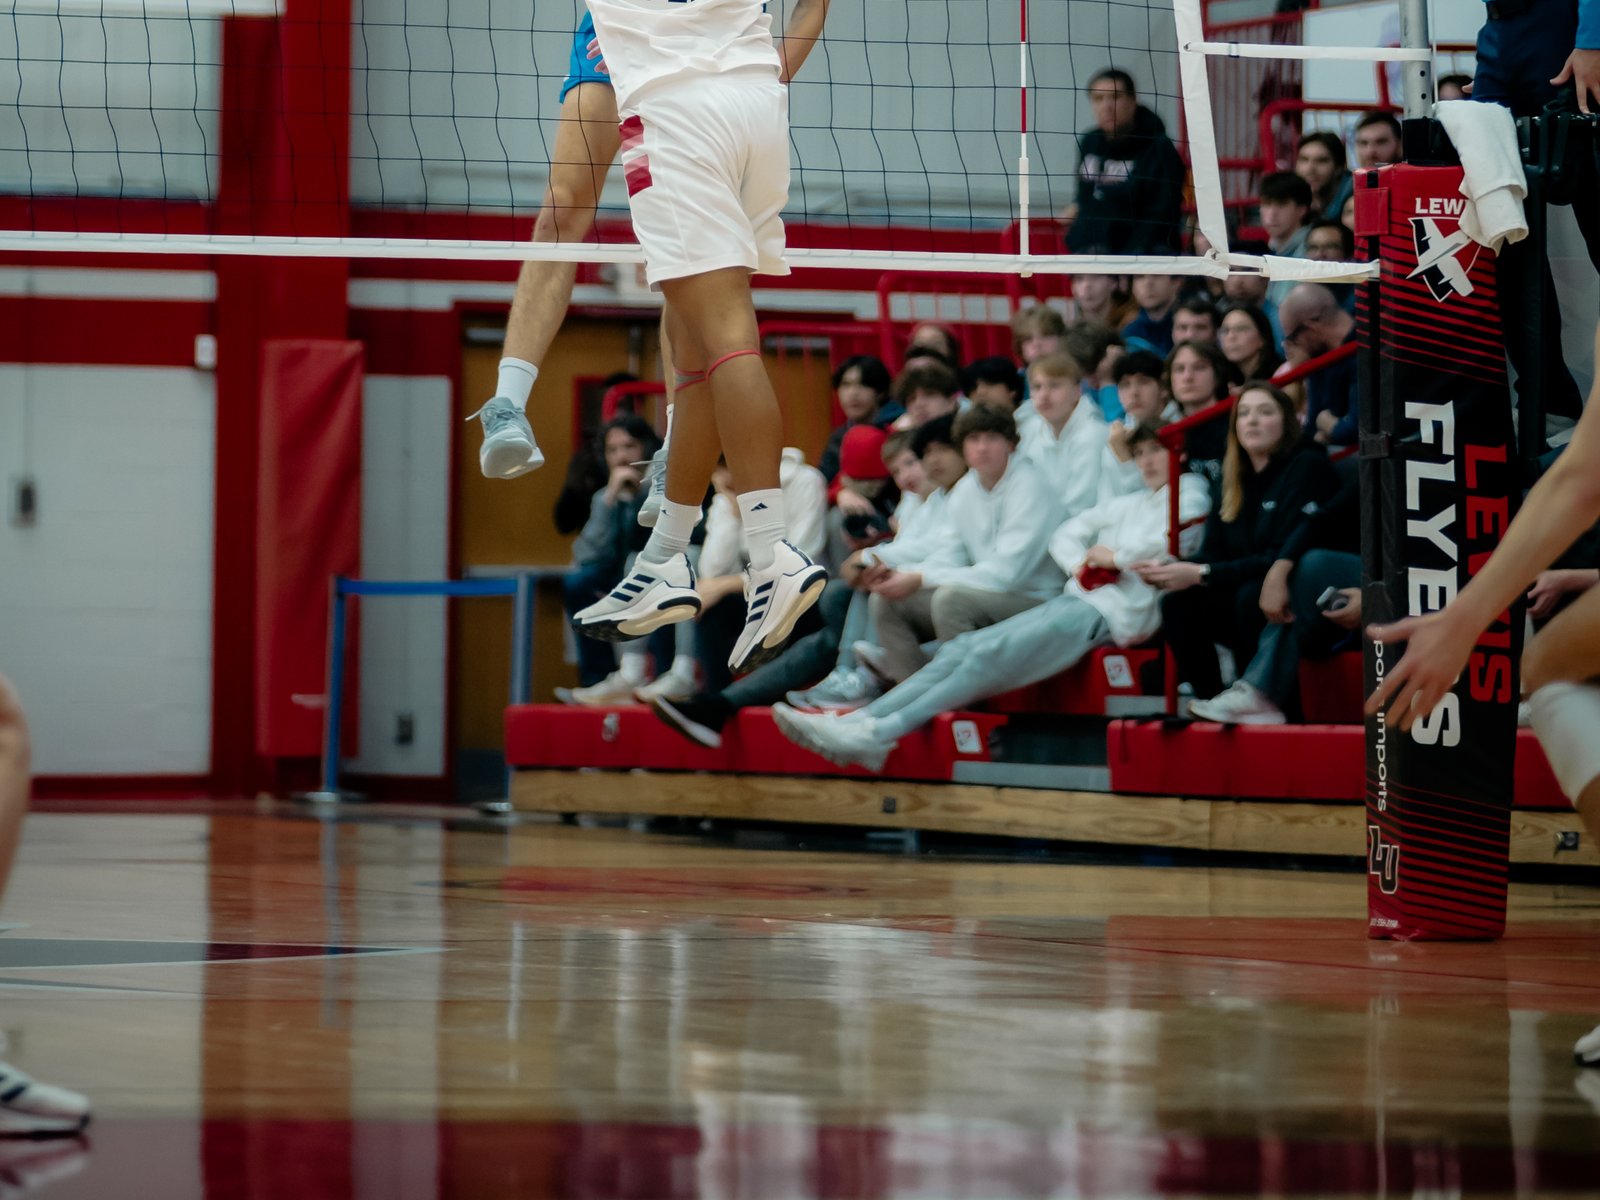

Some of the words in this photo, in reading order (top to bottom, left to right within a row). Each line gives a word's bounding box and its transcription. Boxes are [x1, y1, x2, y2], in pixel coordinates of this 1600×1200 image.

[1415, 197, 1465, 215] LEW
[1405, 400, 1461, 747] FLYES
[1464, 443, 1512, 704] LEIS
[1376, 712, 1388, 812] imports
